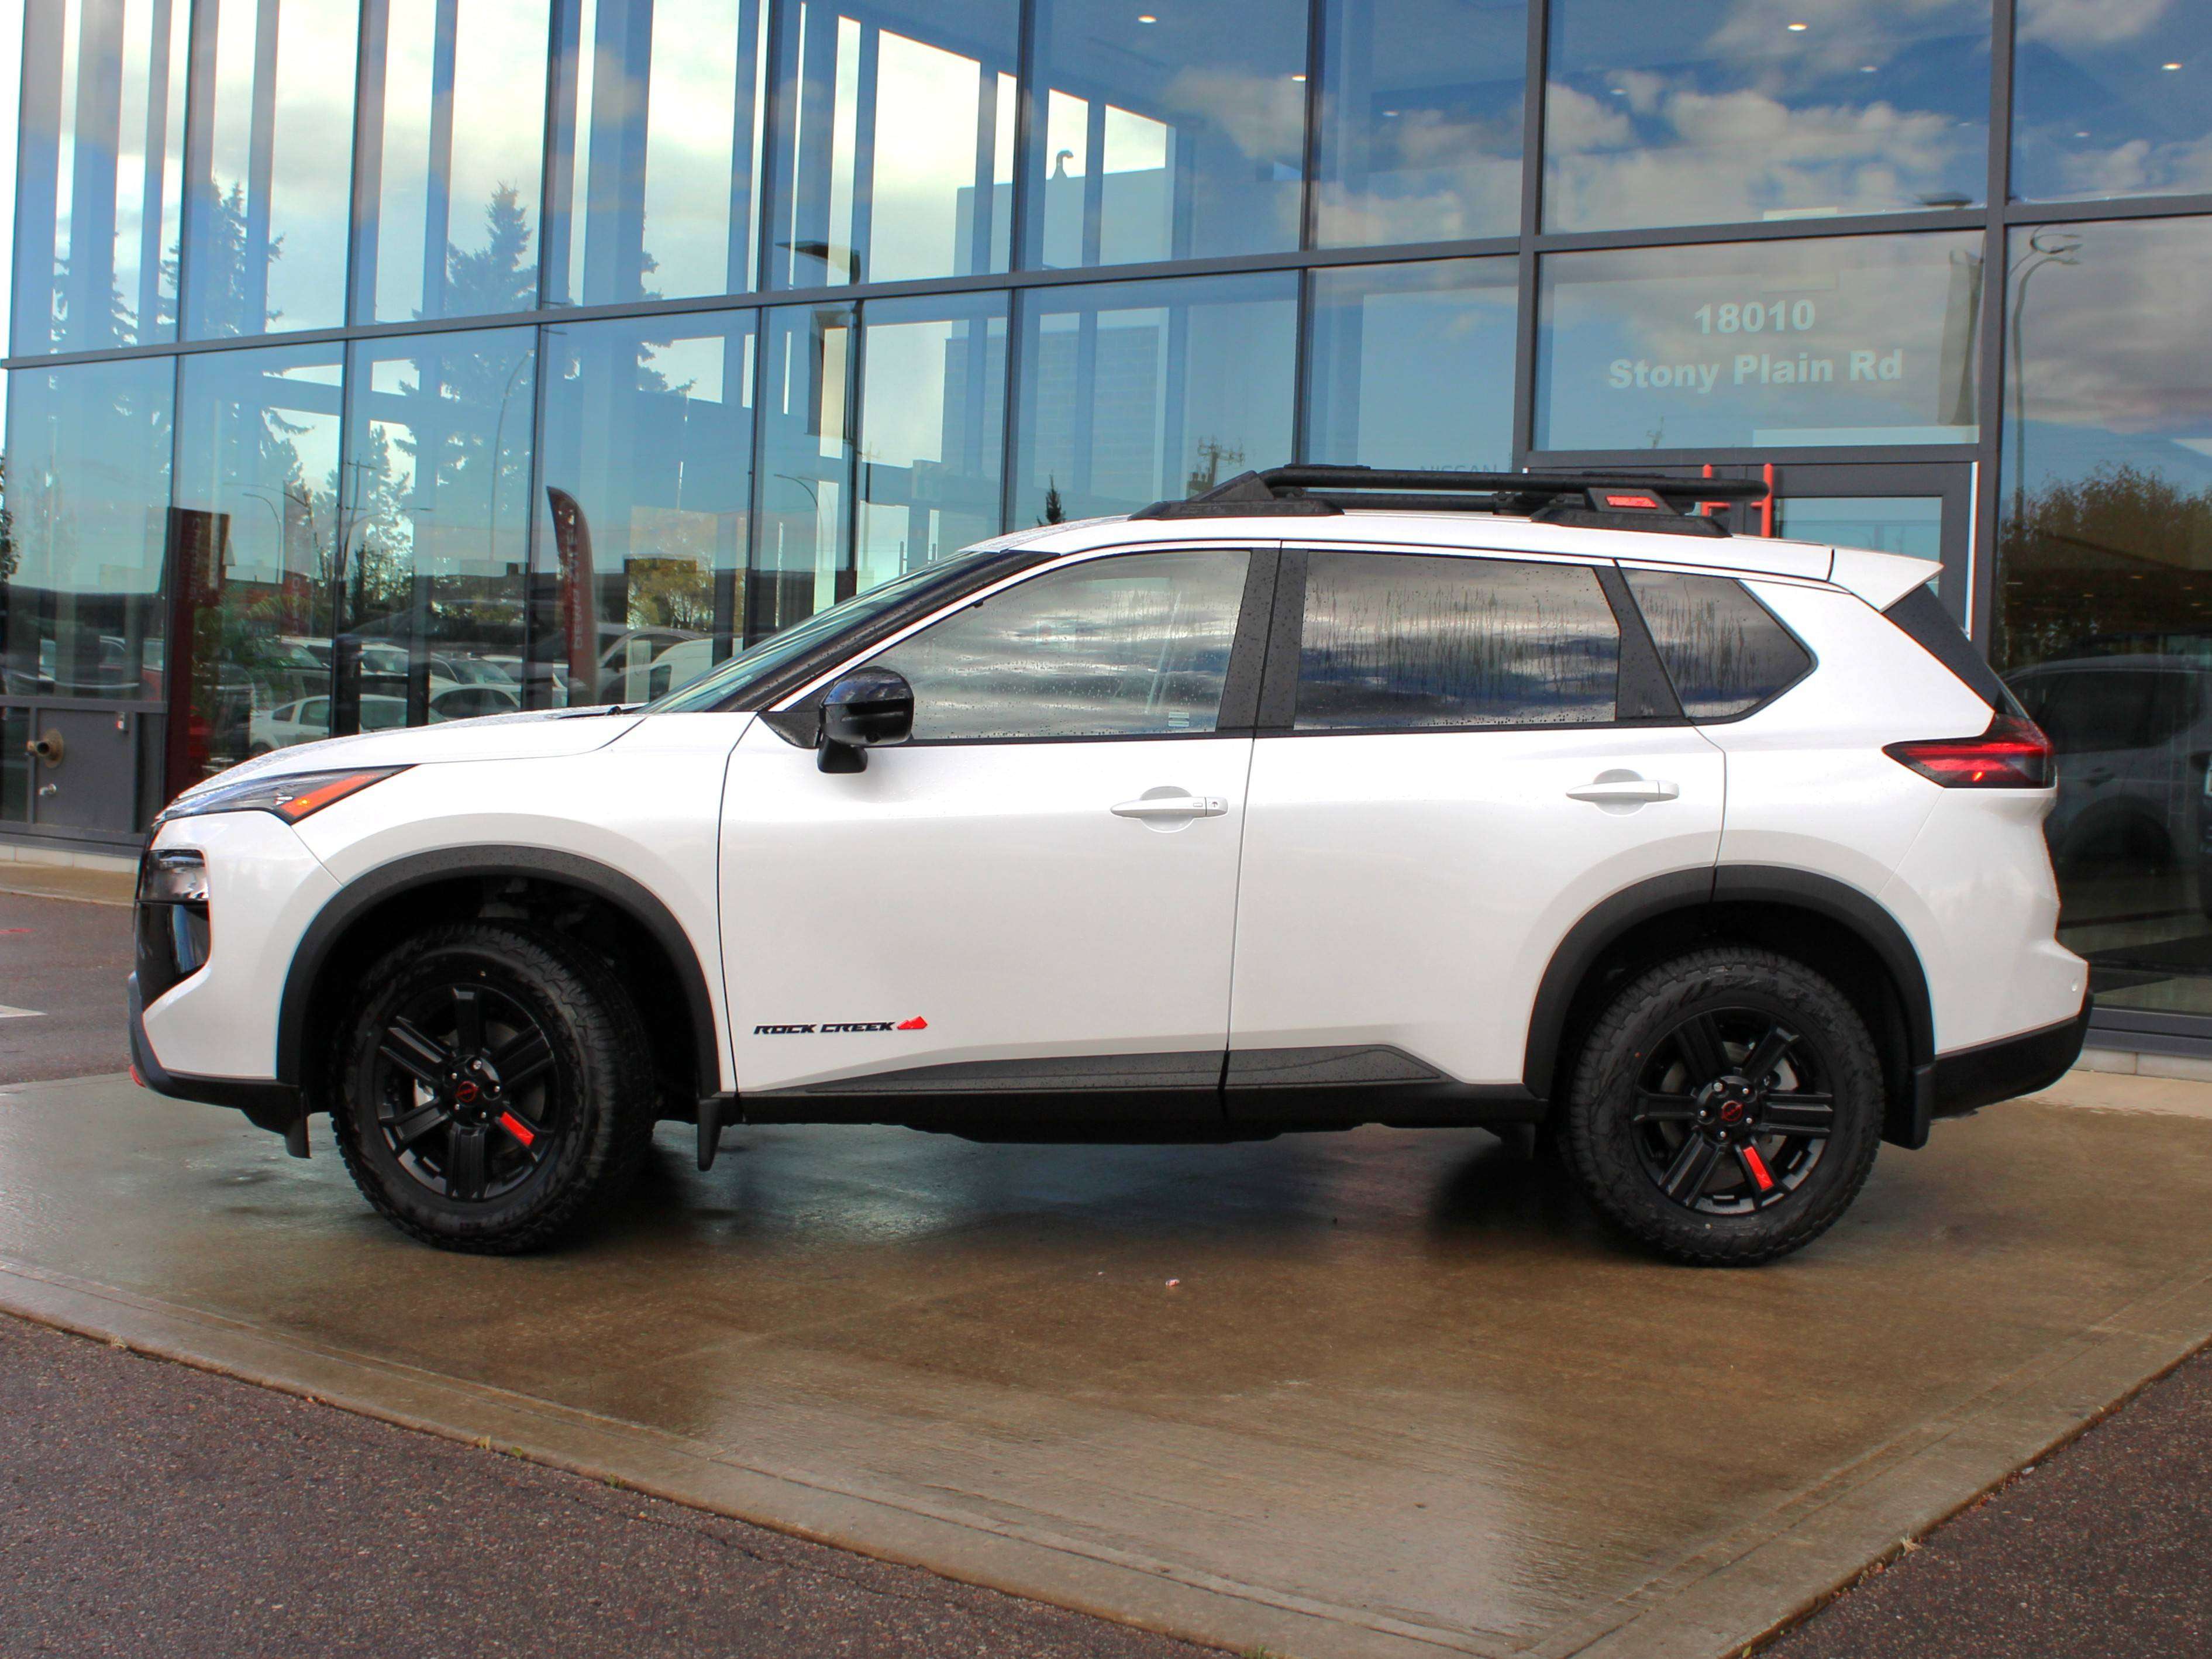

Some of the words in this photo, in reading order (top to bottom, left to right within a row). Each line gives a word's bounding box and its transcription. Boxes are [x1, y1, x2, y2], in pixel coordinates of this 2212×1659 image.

[1694, 299, 1815, 334] 18010
[1608, 357, 1721, 394] Stony
[1733, 353, 1834, 385] Plain
[1849, 349, 1903, 381] Rd
[753, 1024, 817, 1034] ROCK
[820, 1021, 895, 1033] CREEK
